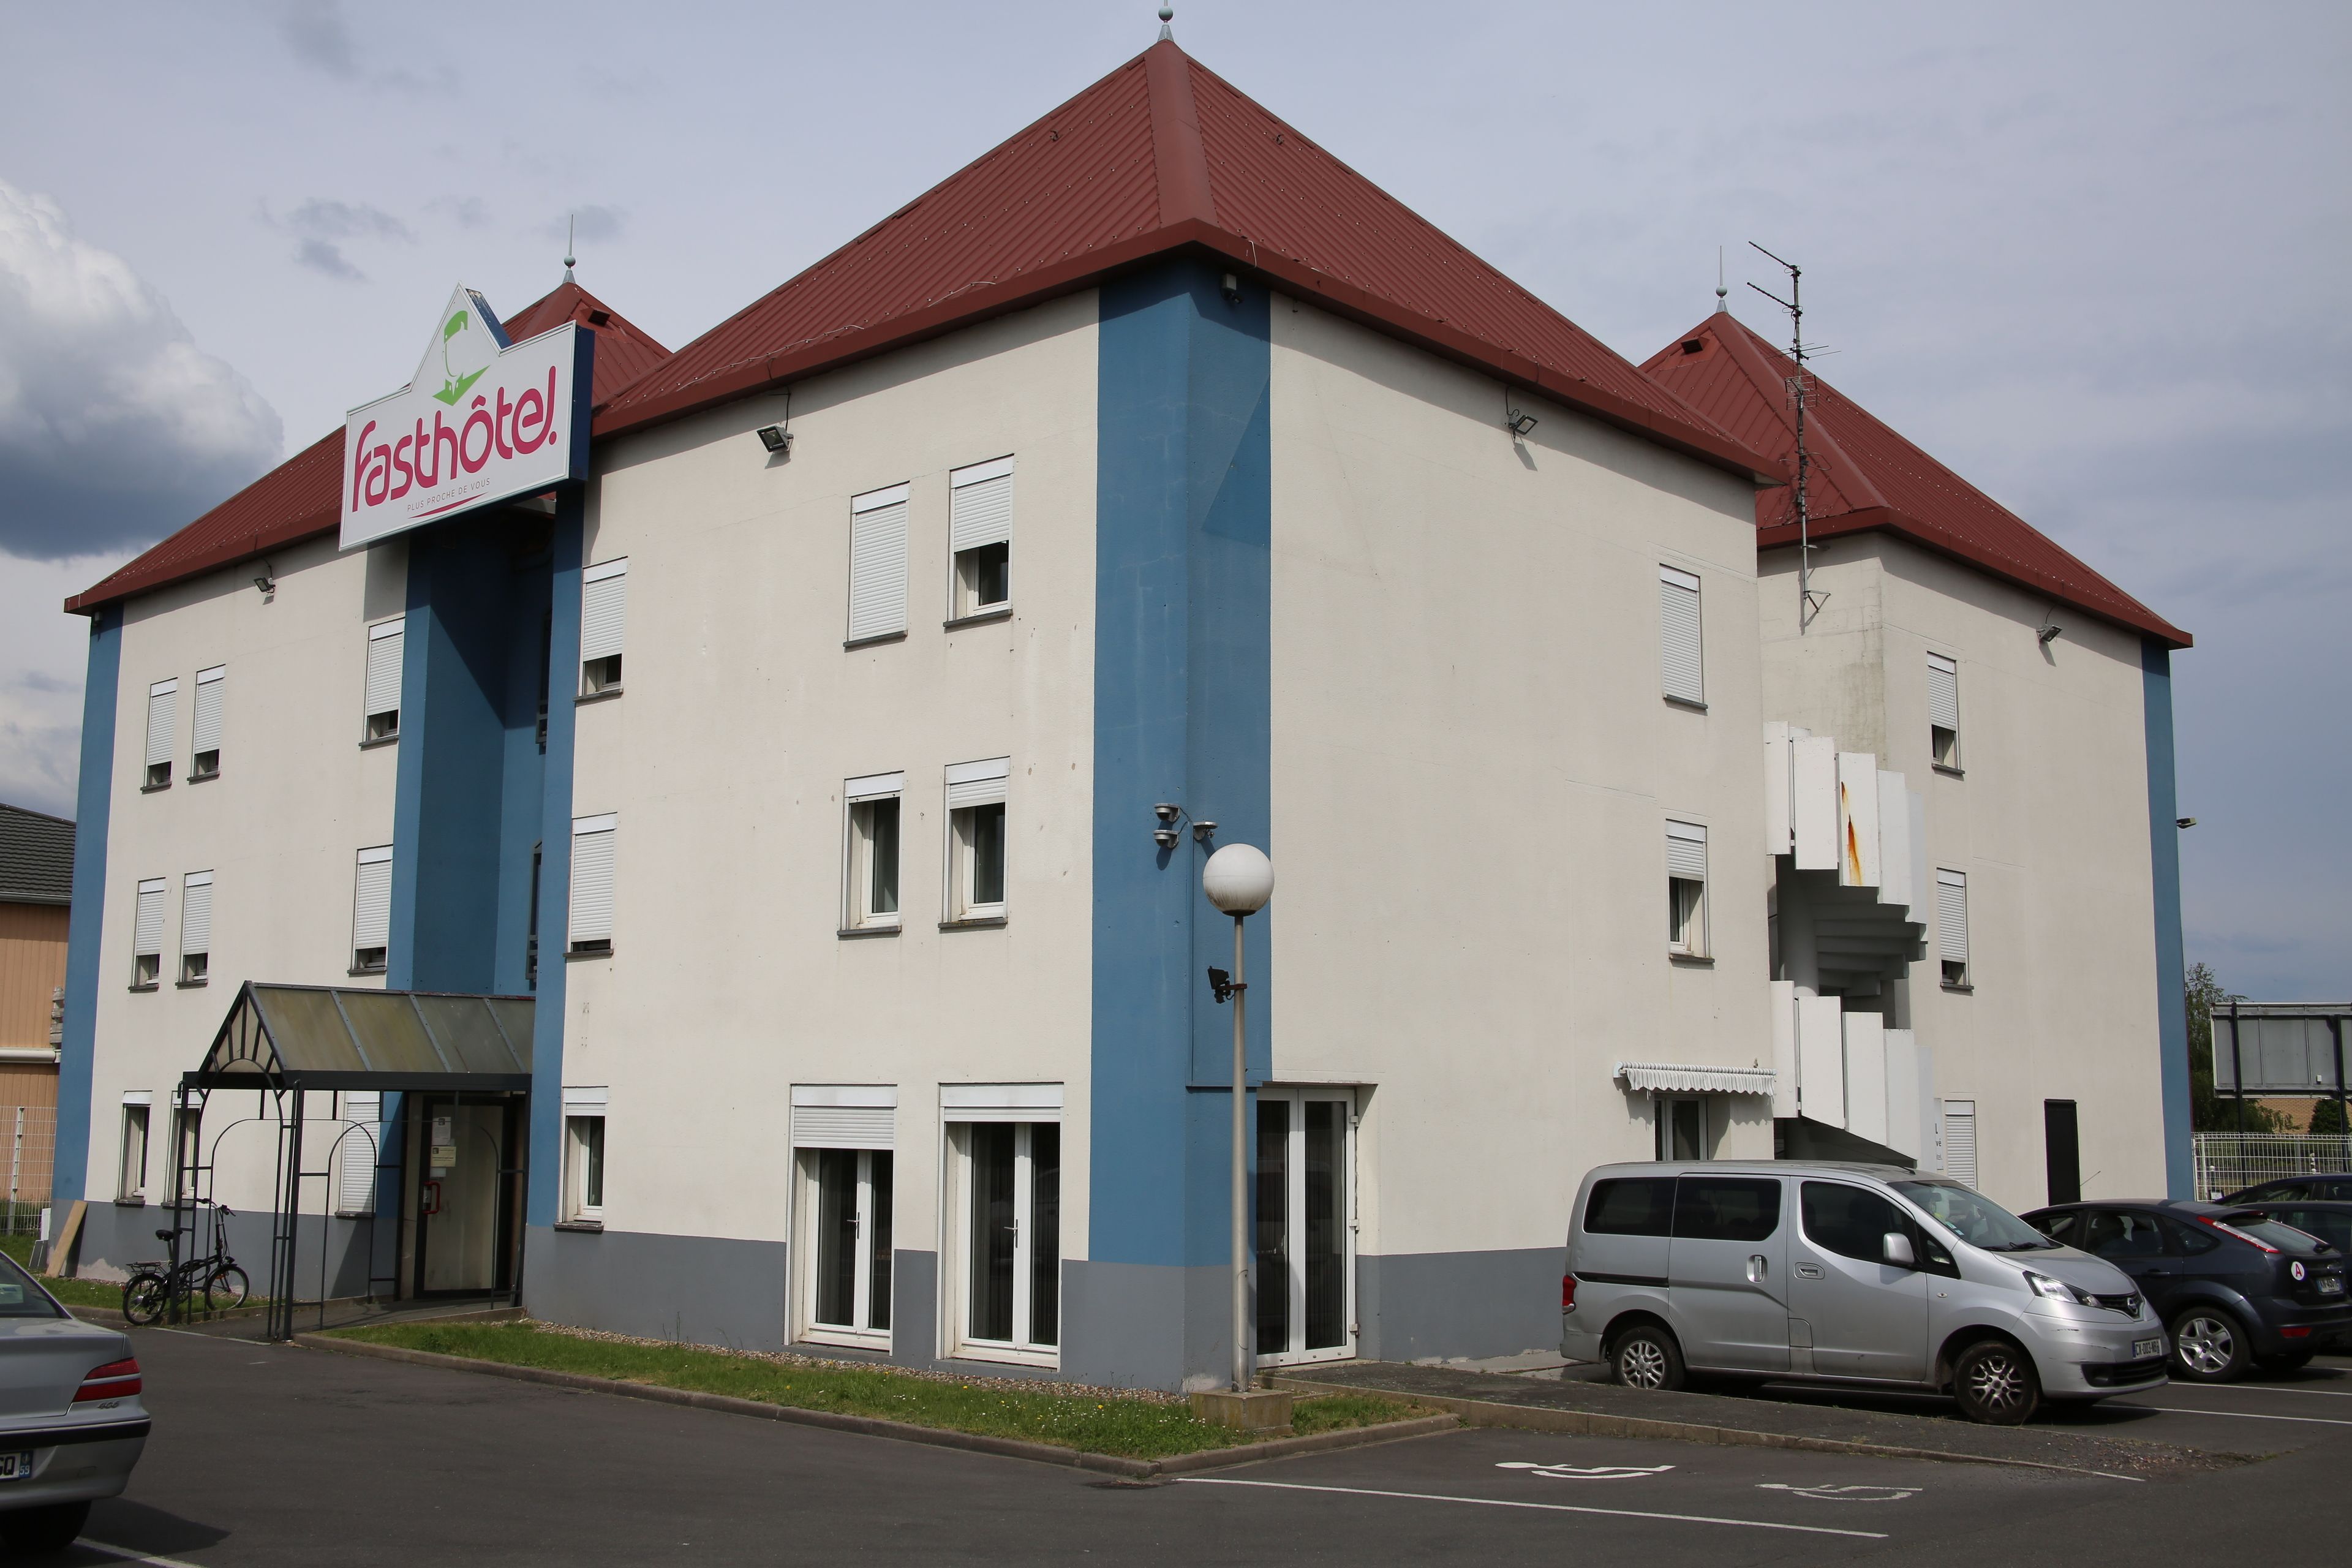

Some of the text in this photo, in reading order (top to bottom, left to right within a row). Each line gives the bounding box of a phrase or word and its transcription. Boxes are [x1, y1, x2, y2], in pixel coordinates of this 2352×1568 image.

[407, 477, 491, 511] PLUS PROCHE DE VOUS
[2295, 1263, 2302, 1277] A
[20, 1464, 30, 1475] 59
